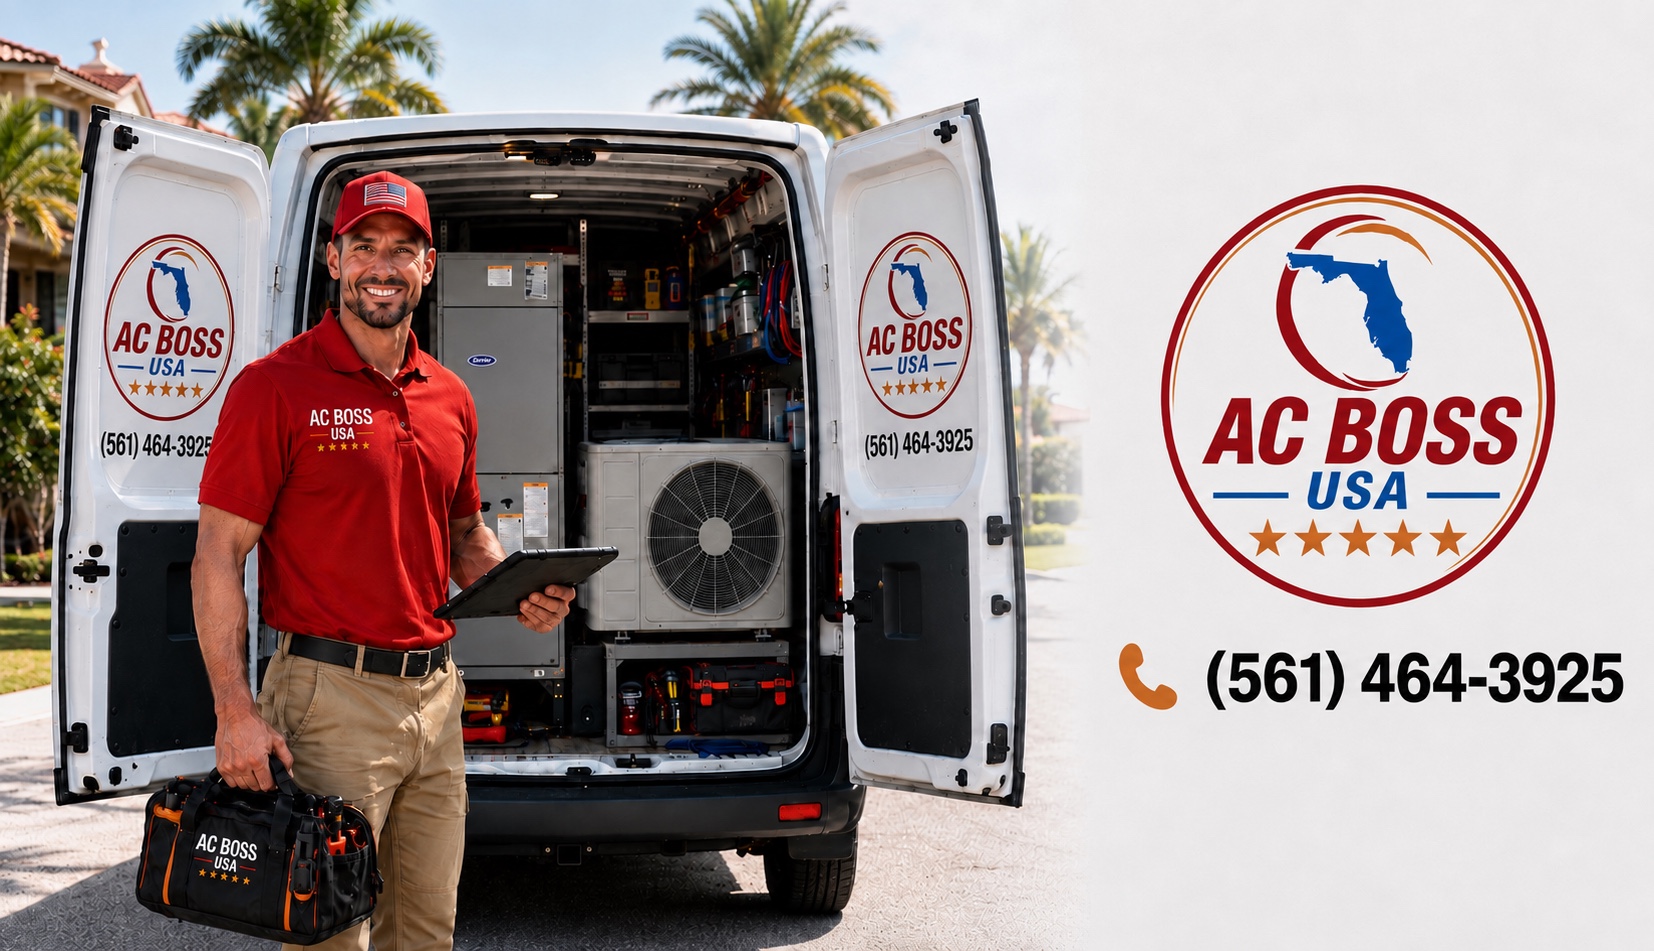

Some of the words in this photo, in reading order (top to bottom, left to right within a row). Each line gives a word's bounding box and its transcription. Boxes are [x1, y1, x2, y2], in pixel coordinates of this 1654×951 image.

[113, 322, 151, 354] AC
[155, 325, 225, 358] BOSS
[866, 324, 896, 356] AC
[901, 316, 963, 353] BOSS
[149, 357, 185, 376] USA
[897, 354, 929, 374] USA
[309, 409, 329, 426] AC
[333, 408, 373, 425] BOSS
[101, 431, 139, 460] (561)
[331, 427, 355, 440] USA
[865, 432, 899, 460] (561)
[902, 428, 973, 455] 464-3925
[195, 833, 218, 853] AC
[219, 837, 258, 861] BOSS
[214, 856, 237, 872] USA
